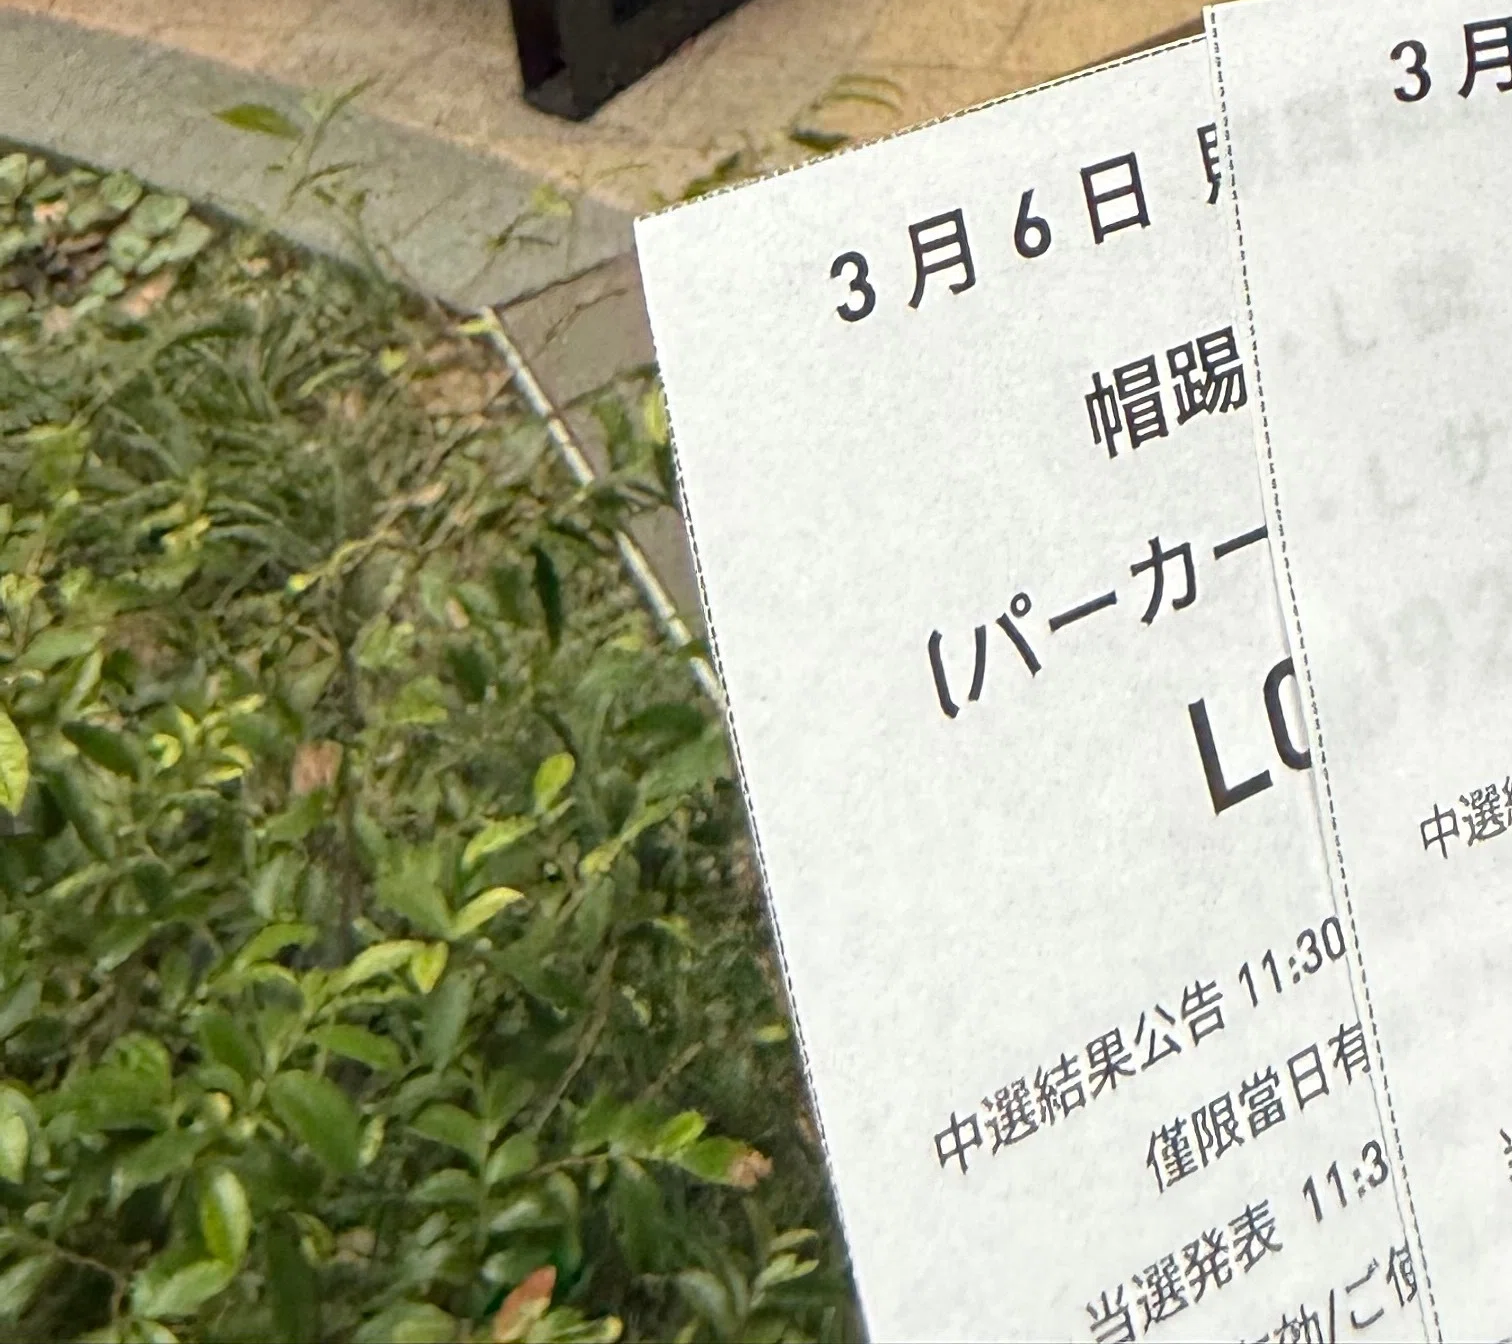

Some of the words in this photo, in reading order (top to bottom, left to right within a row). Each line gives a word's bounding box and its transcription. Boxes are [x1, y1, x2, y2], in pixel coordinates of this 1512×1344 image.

[1086, 325, 1248, 459] 帽踢
[934, 979, 1227, 1176] 中選結果公告
[1238, 915, 1346, 1009] 11:30
